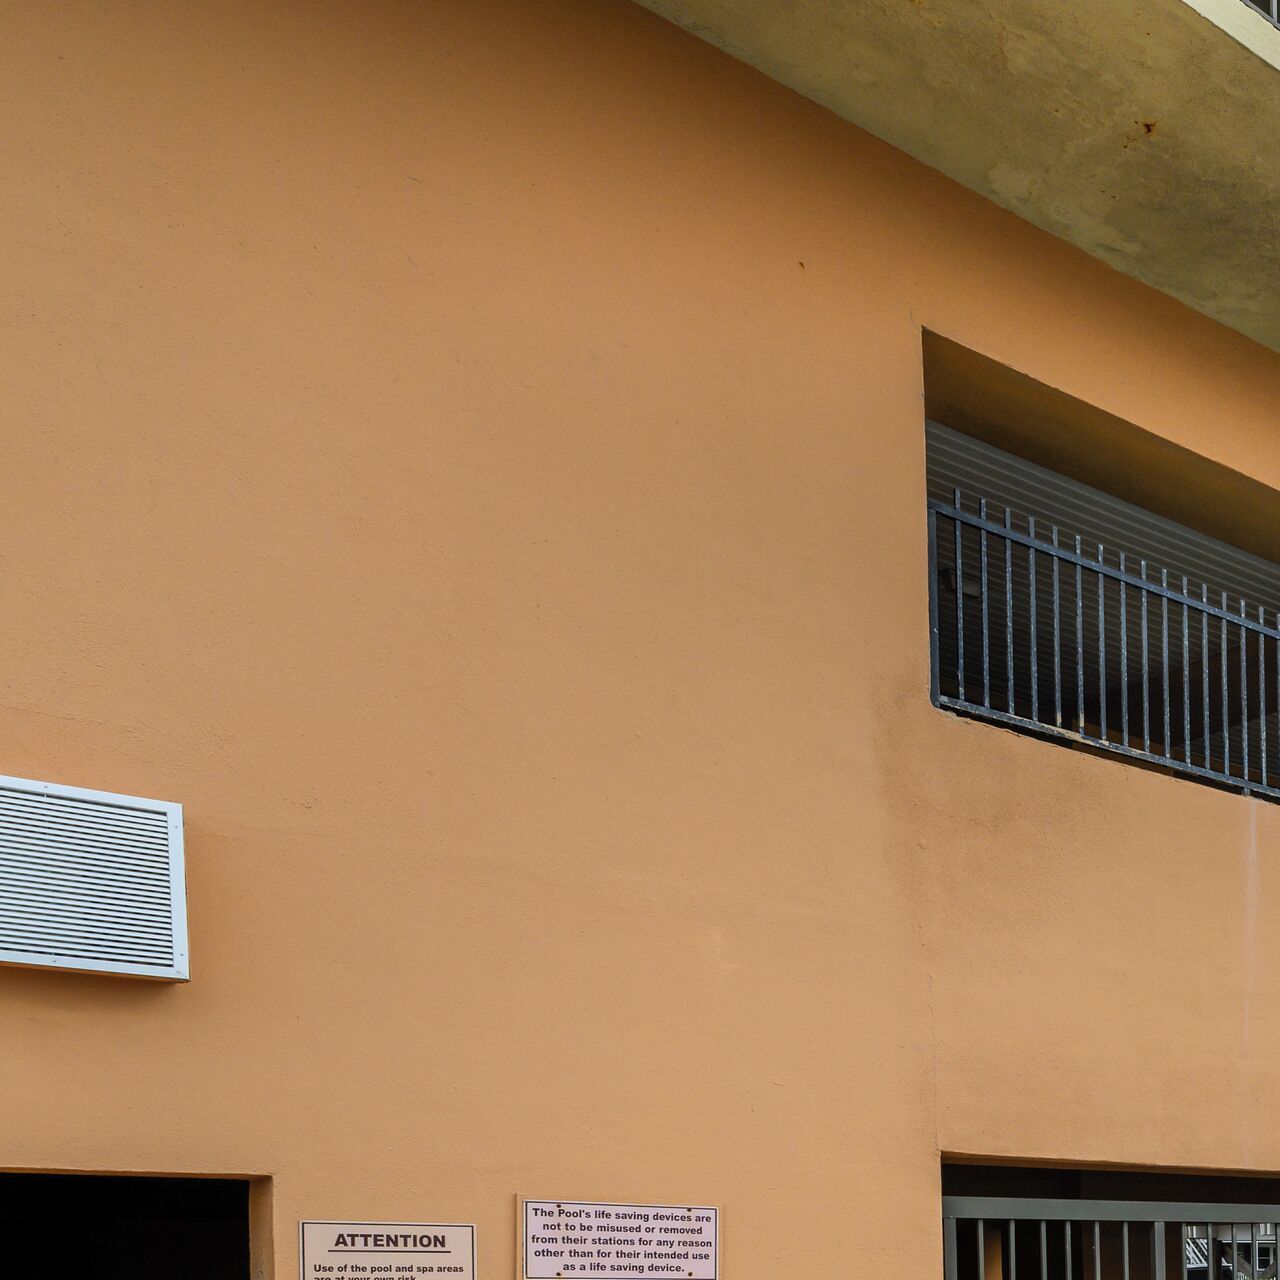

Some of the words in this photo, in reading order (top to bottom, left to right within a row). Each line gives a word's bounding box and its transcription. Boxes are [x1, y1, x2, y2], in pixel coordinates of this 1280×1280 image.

[532, 1208, 554, 1217] The
[558, 1209, 591, 1218] Pool's
[594, 1210, 611, 1219] life
[615, 1212, 649, 1222] saving
[653, 1213, 692, 1221] devices
[565, 1223, 576, 1231] to
[580, 1223, 593, 1231] be
[596, 1224, 641, 1233] misused
[659, 1226, 703, 1234] removed
[334, 1233, 446, 1248] ATTENTION
[531, 1235, 558, 1244] from
[561, 1236, 588, 1244] their
[591, 1237, 635, 1245] stations
[638, 1238, 653, 1246] for
[656, 1240, 675, 1248] any
[534, 1249, 564, 1257] other
[569, 1249, 593, 1258] than
[597, 1249, 611, 1258] for
[615, 1250, 641, 1258] their
[644, 1251, 689, 1259] intended
[313, 1264, 334, 1272] Use
[337, 1264, 348, 1272] of
[351, 1264, 367, 1272] the
[370, 1264, 392, 1274] pool
[416, 1266, 434, 1274] spa
[590, 1263, 606, 1271] life
[610, 1263, 644, 1273] saving
[648, 1263, 685, 1272] device.
